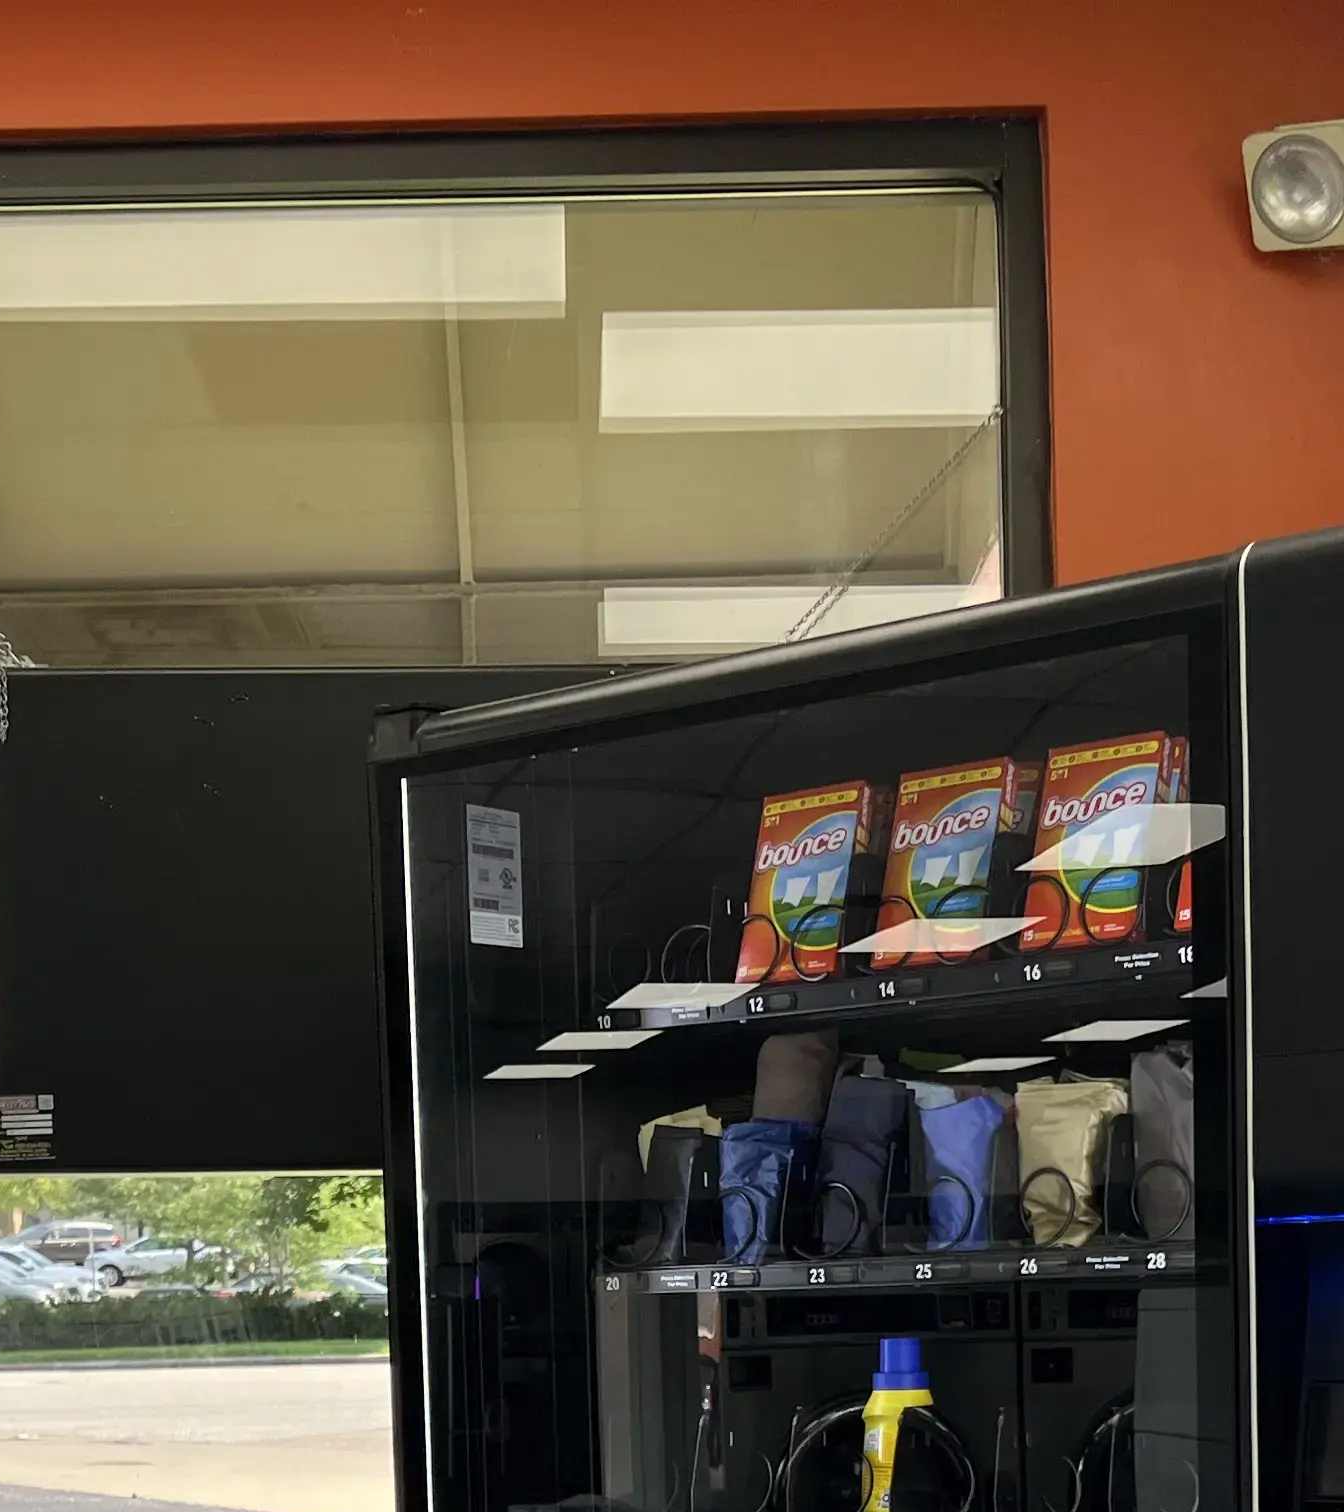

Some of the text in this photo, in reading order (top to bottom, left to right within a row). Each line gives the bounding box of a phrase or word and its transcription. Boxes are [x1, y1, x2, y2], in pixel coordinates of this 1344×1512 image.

[1041, 781, 1147, 830] bounce
[892, 806, 991, 853] bounce
[756, 827, 847, 873] bounce
[1022, 930, 1035, 942] 15
[1023, 964, 1042, 981] 16
[878, 981, 895, 998] 14
[748, 996, 764, 1013] 12
[597, 1015, 611, 1030] 10
[1019, 1258, 1038, 1275] 26
[1146, 1252, 1167, 1270] 28
[712, 1271, 728, 1287] 22
[809, 1268, 826, 1284] 23
[915, 1263, 932, 1279] 25
[605, 1276, 620, 1291] 20
